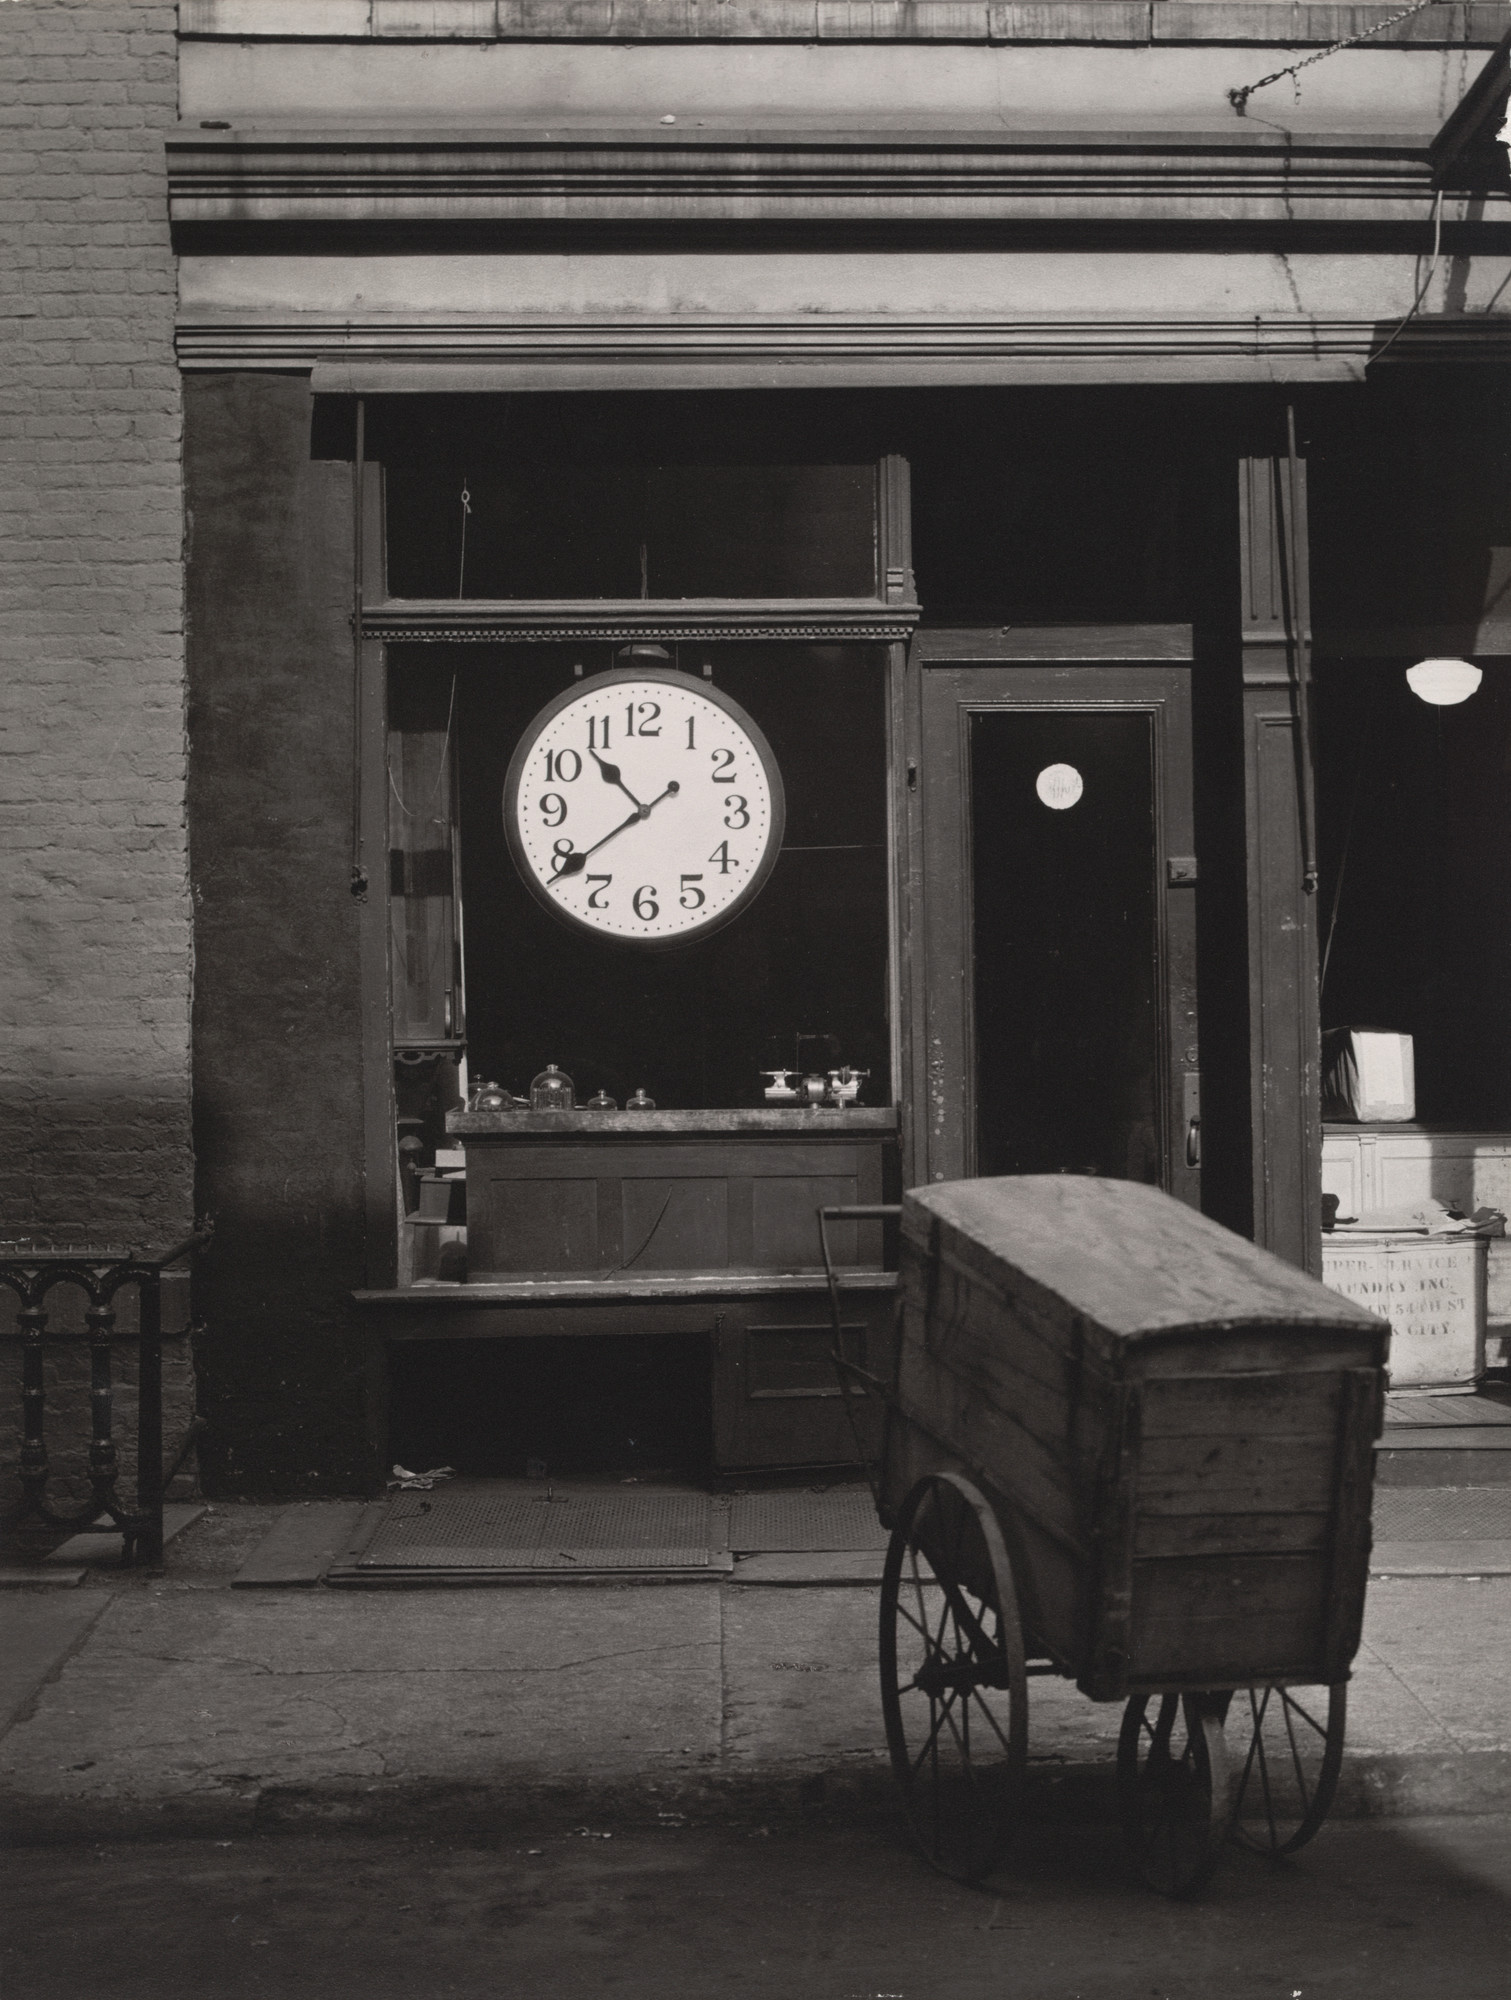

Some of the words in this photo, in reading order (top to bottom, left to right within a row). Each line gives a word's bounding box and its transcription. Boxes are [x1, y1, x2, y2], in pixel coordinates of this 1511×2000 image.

[586, 715, 612, 749] 11
[625, 702, 662, 737] 12
[685, 716, 697, 750] 1
[544, 749, 582, 782] 10
[711, 749, 737, 784] 2
[539, 793, 568, 827] 9
[724, 794, 751, 830] 3
[550, 838, 577, 874] 8
[708, 840, 740, 874] 4
[586, 874, 613, 909] 7
[632, 886, 660, 921] 6
[680, 873, 706, 909] 5
[1334, 1282, 1406, 1294] AUNDRY
